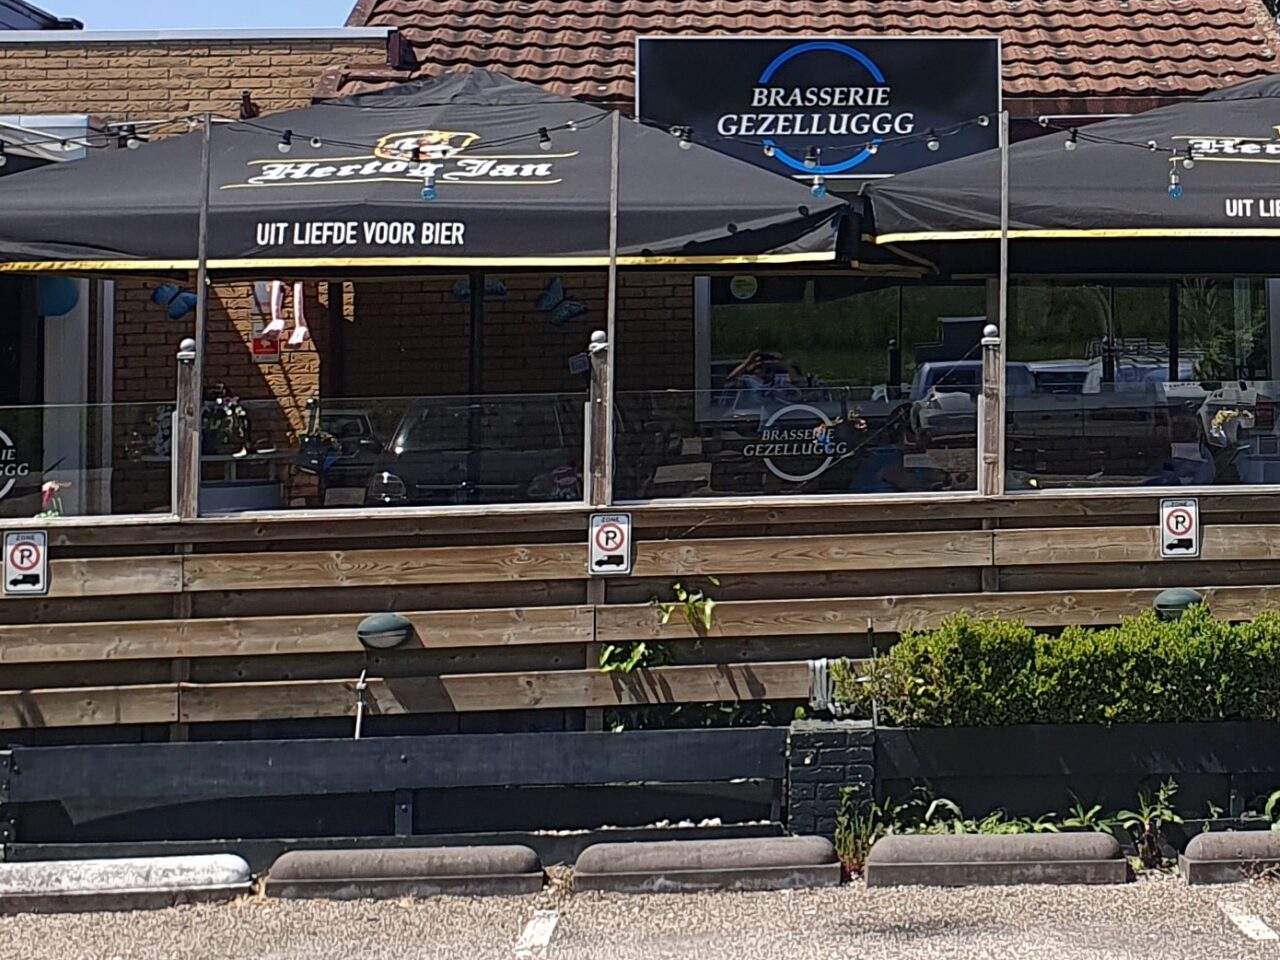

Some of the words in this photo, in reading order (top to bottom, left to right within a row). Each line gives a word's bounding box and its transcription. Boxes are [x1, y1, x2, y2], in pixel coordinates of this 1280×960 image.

[751, 87, 890, 107] BRASSERIE
[716, 112, 915, 136] GEZELLUGGG
[248, 159, 444, 184] Hertog
[442, 158, 552, 181] Jan
[1225, 198, 1254, 217] UIT
[256, 222, 288, 245] UIT
[292, 222, 358, 245] LIEFDE
[363, 222, 415, 244] VOOR
[420, 222, 465, 245] BIER
